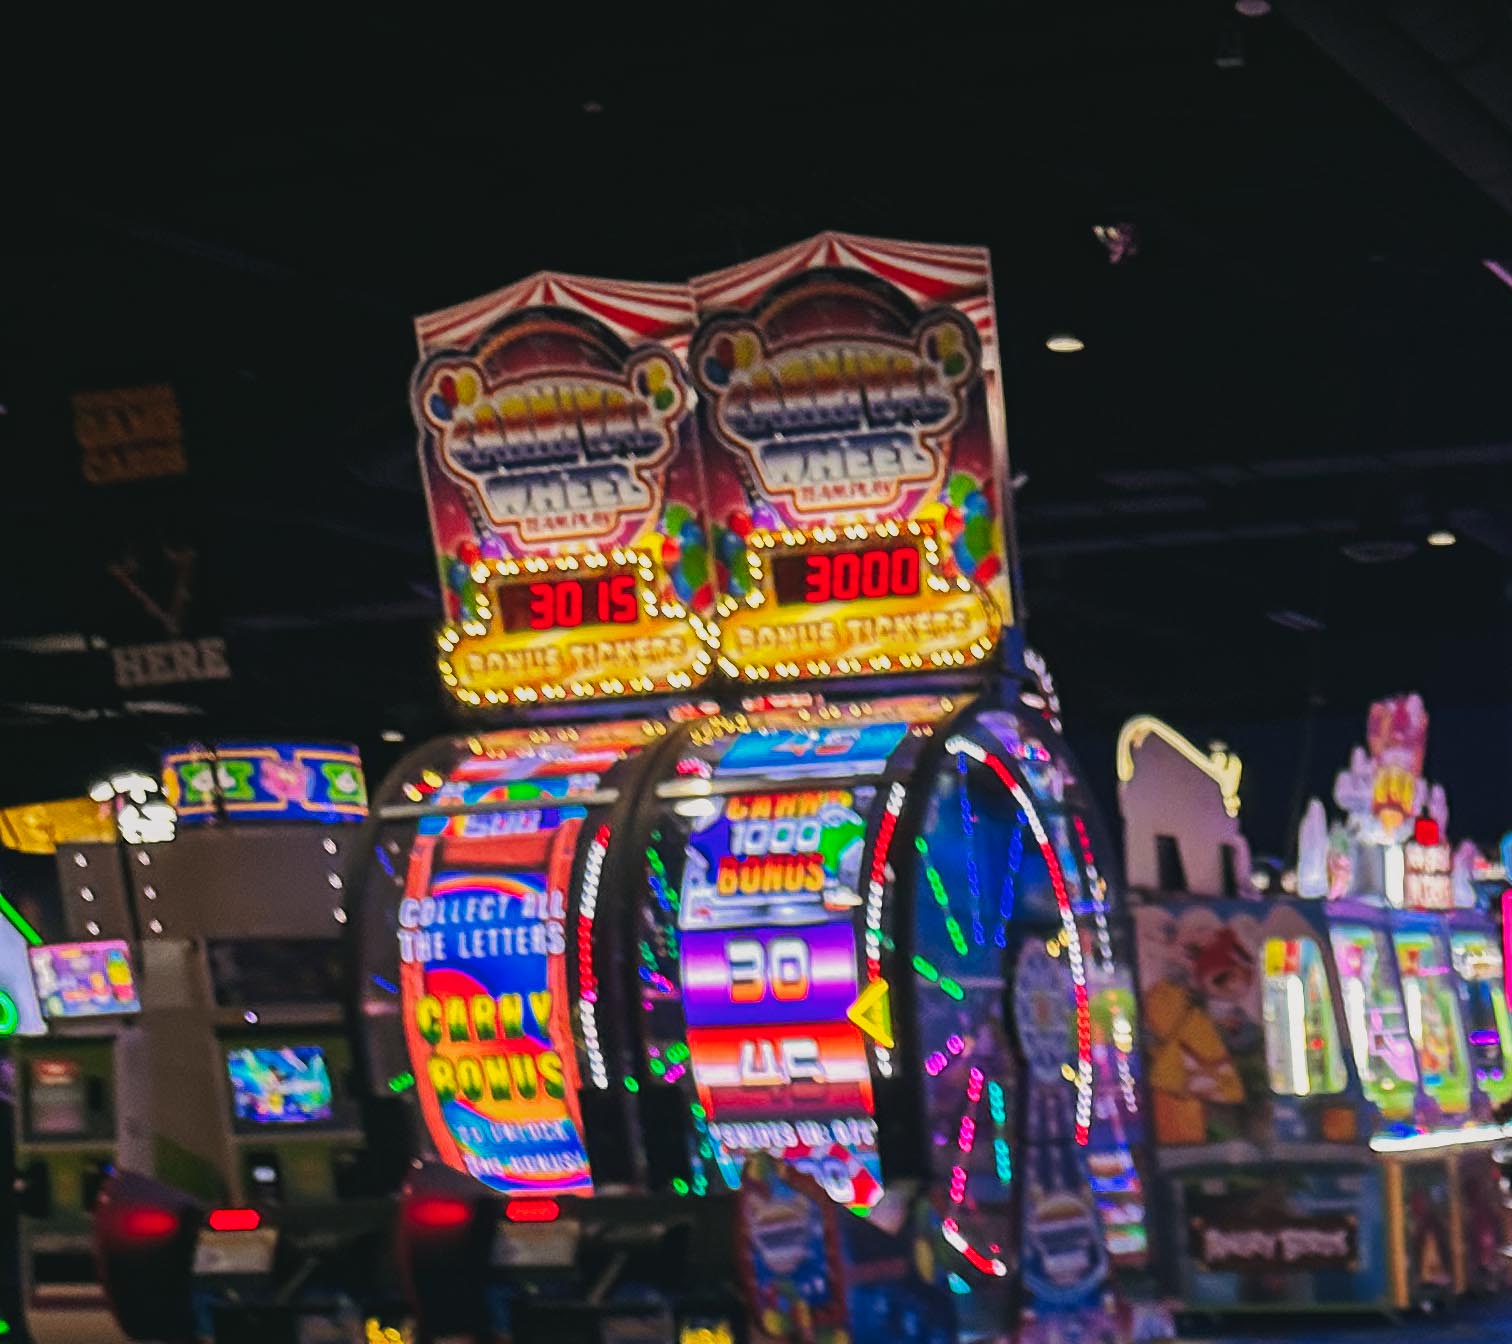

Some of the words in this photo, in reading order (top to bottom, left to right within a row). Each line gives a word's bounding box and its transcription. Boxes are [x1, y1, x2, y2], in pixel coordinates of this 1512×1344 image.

[763, 440, 934, 485] WHEEL
[487, 472, 649, 518] WHEEL
[805, 547, 921, 603] 3000
[530, 575, 637, 631] 3015
[735, 622, 836, 655] BONUS
[846, 609, 968, 643] TICKETS
[112, 637, 231, 688] HERE
[466, 645, 560, 677] BONUS
[729, 818, 823, 855] 1000
[717, 852, 825, 896] BONUS
[399, 895, 511, 927] COLLECT
[397, 929, 447, 963] THE
[457, 921, 567, 959] LETTERS
[726, 938, 809, 1004] 30
[415, 991, 552, 1044] CARNY
[428, 1051, 566, 1105] BONUS
